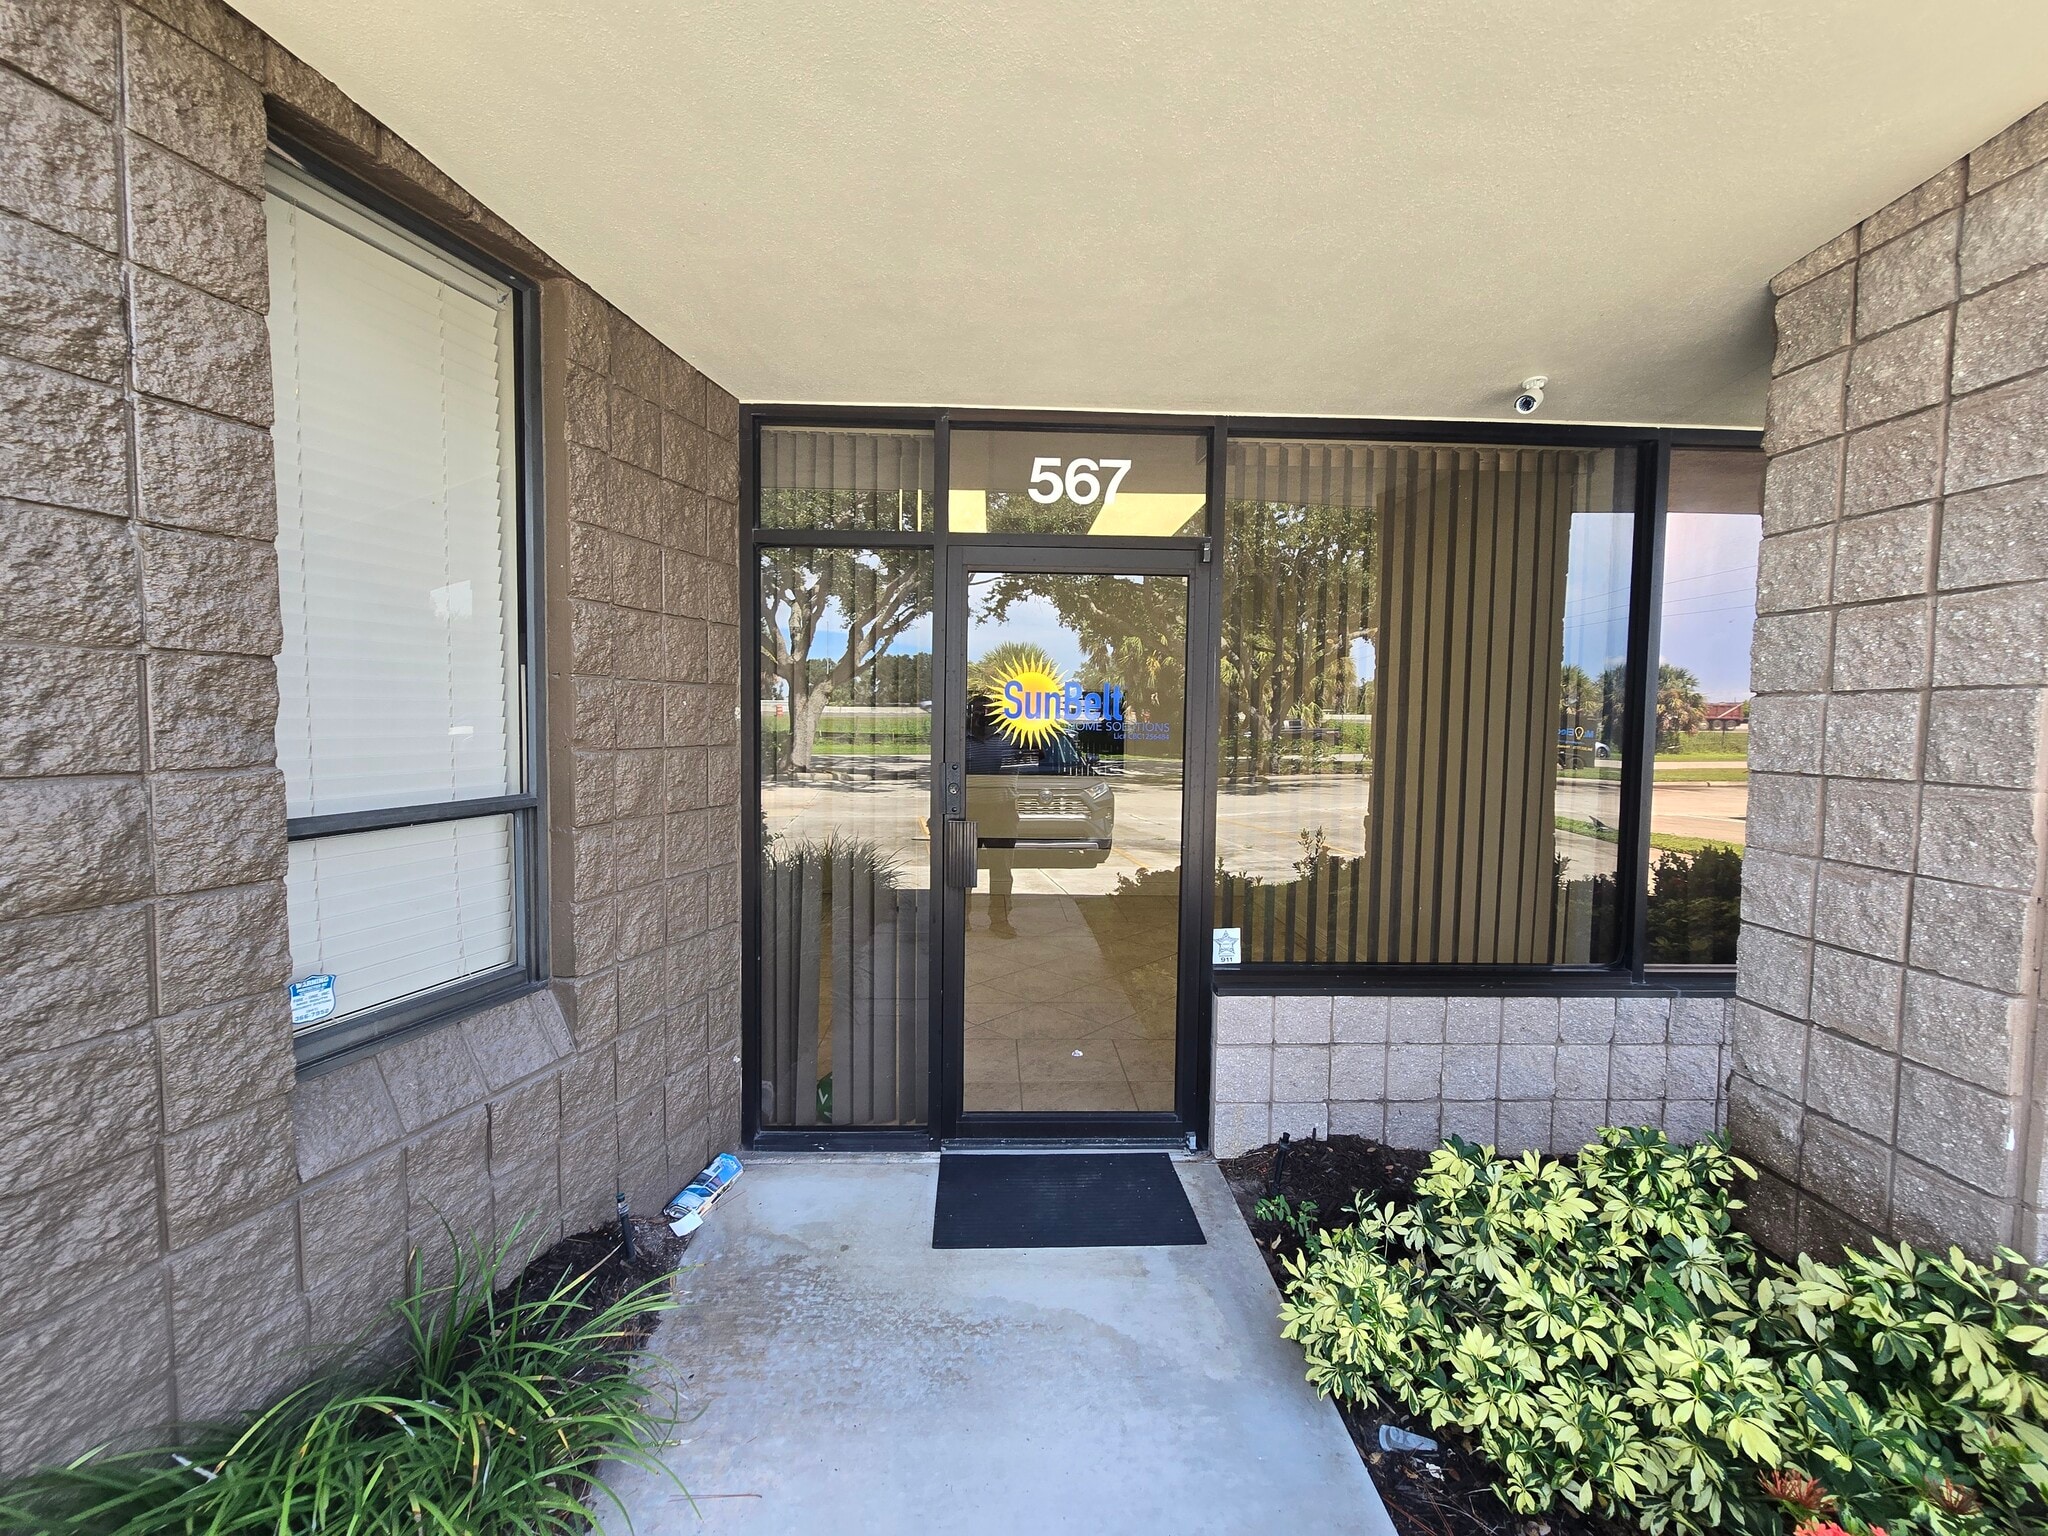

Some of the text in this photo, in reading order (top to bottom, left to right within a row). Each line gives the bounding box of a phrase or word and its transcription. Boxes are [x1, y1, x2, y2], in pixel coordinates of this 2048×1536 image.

[1028, 457, 1132, 505] 567
[1004, 680, 1124, 720] SunBelt
[1068, 721, 1170, 732] HOME SOLUTIONS
